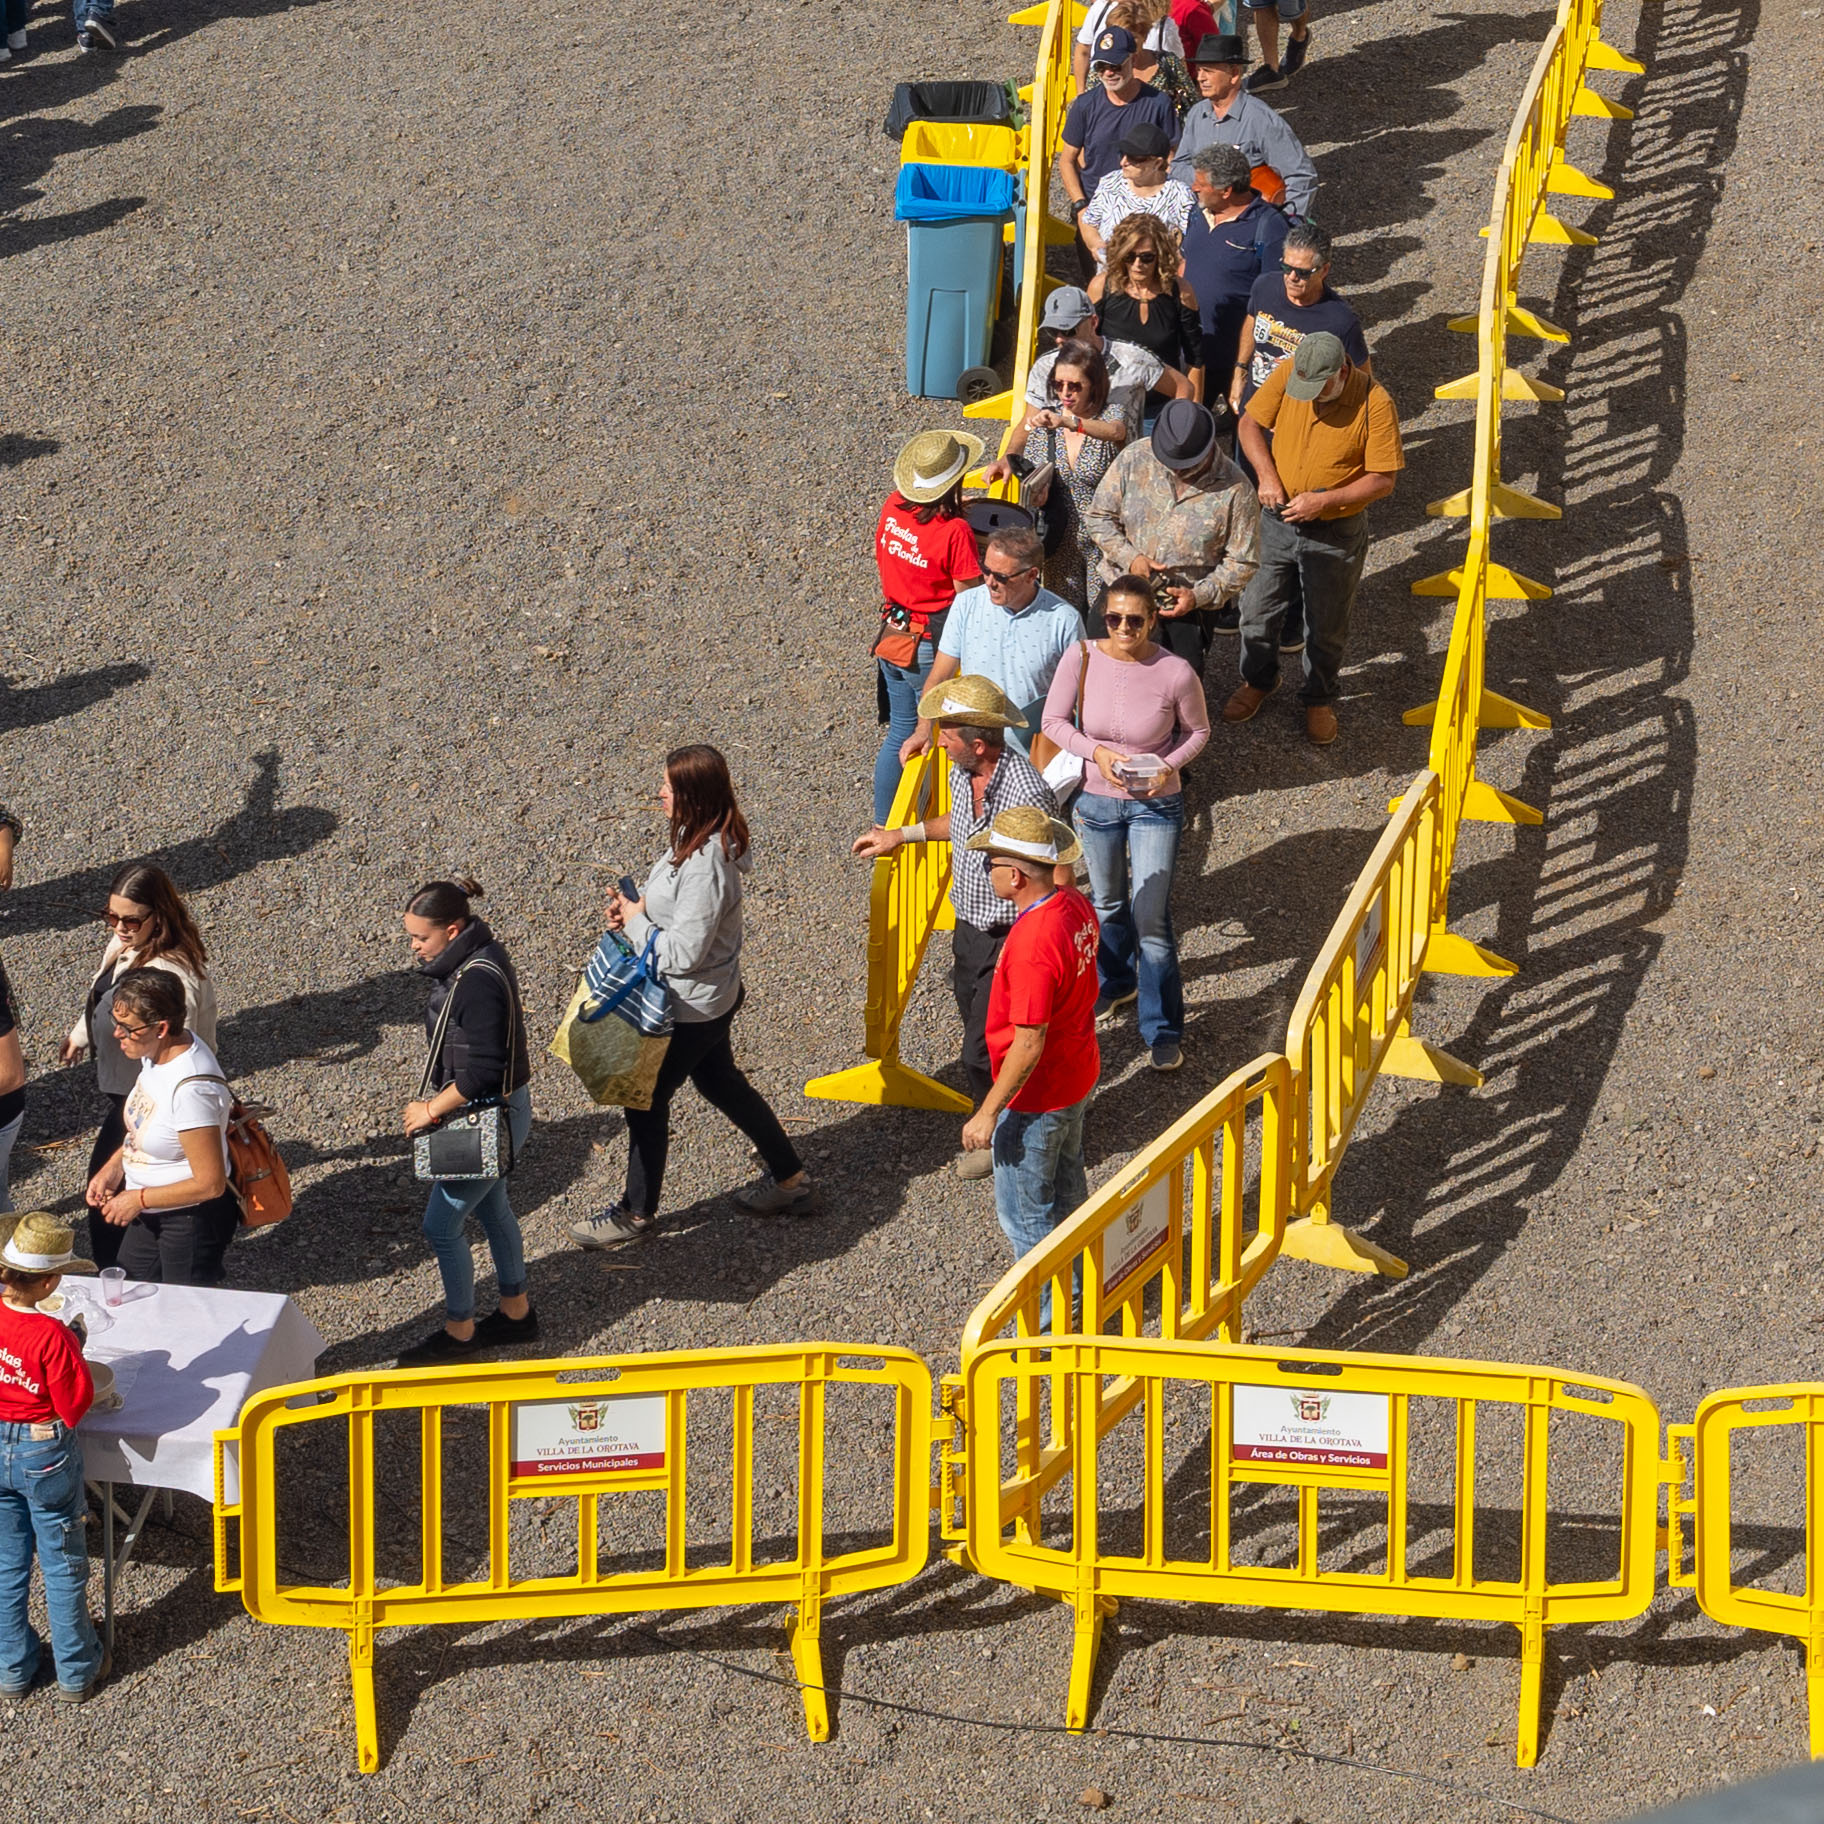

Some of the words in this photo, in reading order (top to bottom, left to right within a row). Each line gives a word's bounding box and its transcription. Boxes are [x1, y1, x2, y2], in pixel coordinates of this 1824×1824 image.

[884, 516, 919, 546] Fiestas
[888, 540, 929, 569] Florida
[911, 543, 920, 554] de
[15, 1366, 27, 1378] de
[1280, 1425, 1341, 1437] Ayuntamiento
[557, 1435, 619, 1447] Ayuntamiento
[1258, 1433, 1287, 1443] VILLA
[1289, 1435, 1302, 1444] DE
[1304, 1436, 1315, 1444] LA
[1317, 1436, 1363, 1448] OROTAVA
[536, 1446, 566, 1456] VILLA
[567, 1445, 580, 1455] DE
[581, 1444, 592, 1454] LA
[593, 1442, 641, 1454] OROTAVA
[1250, 1446, 1278, 1459] Área
[1279, 1449, 1288, 1460] de
[1289, 1451, 1317, 1462] Obras
[1318, 1454, 1326, 1465] y
[1327, 1453, 1371, 1466] Servicios
[537, 1460, 580, 1472] Servicios
[581, 1456, 639, 1470] Municipales
